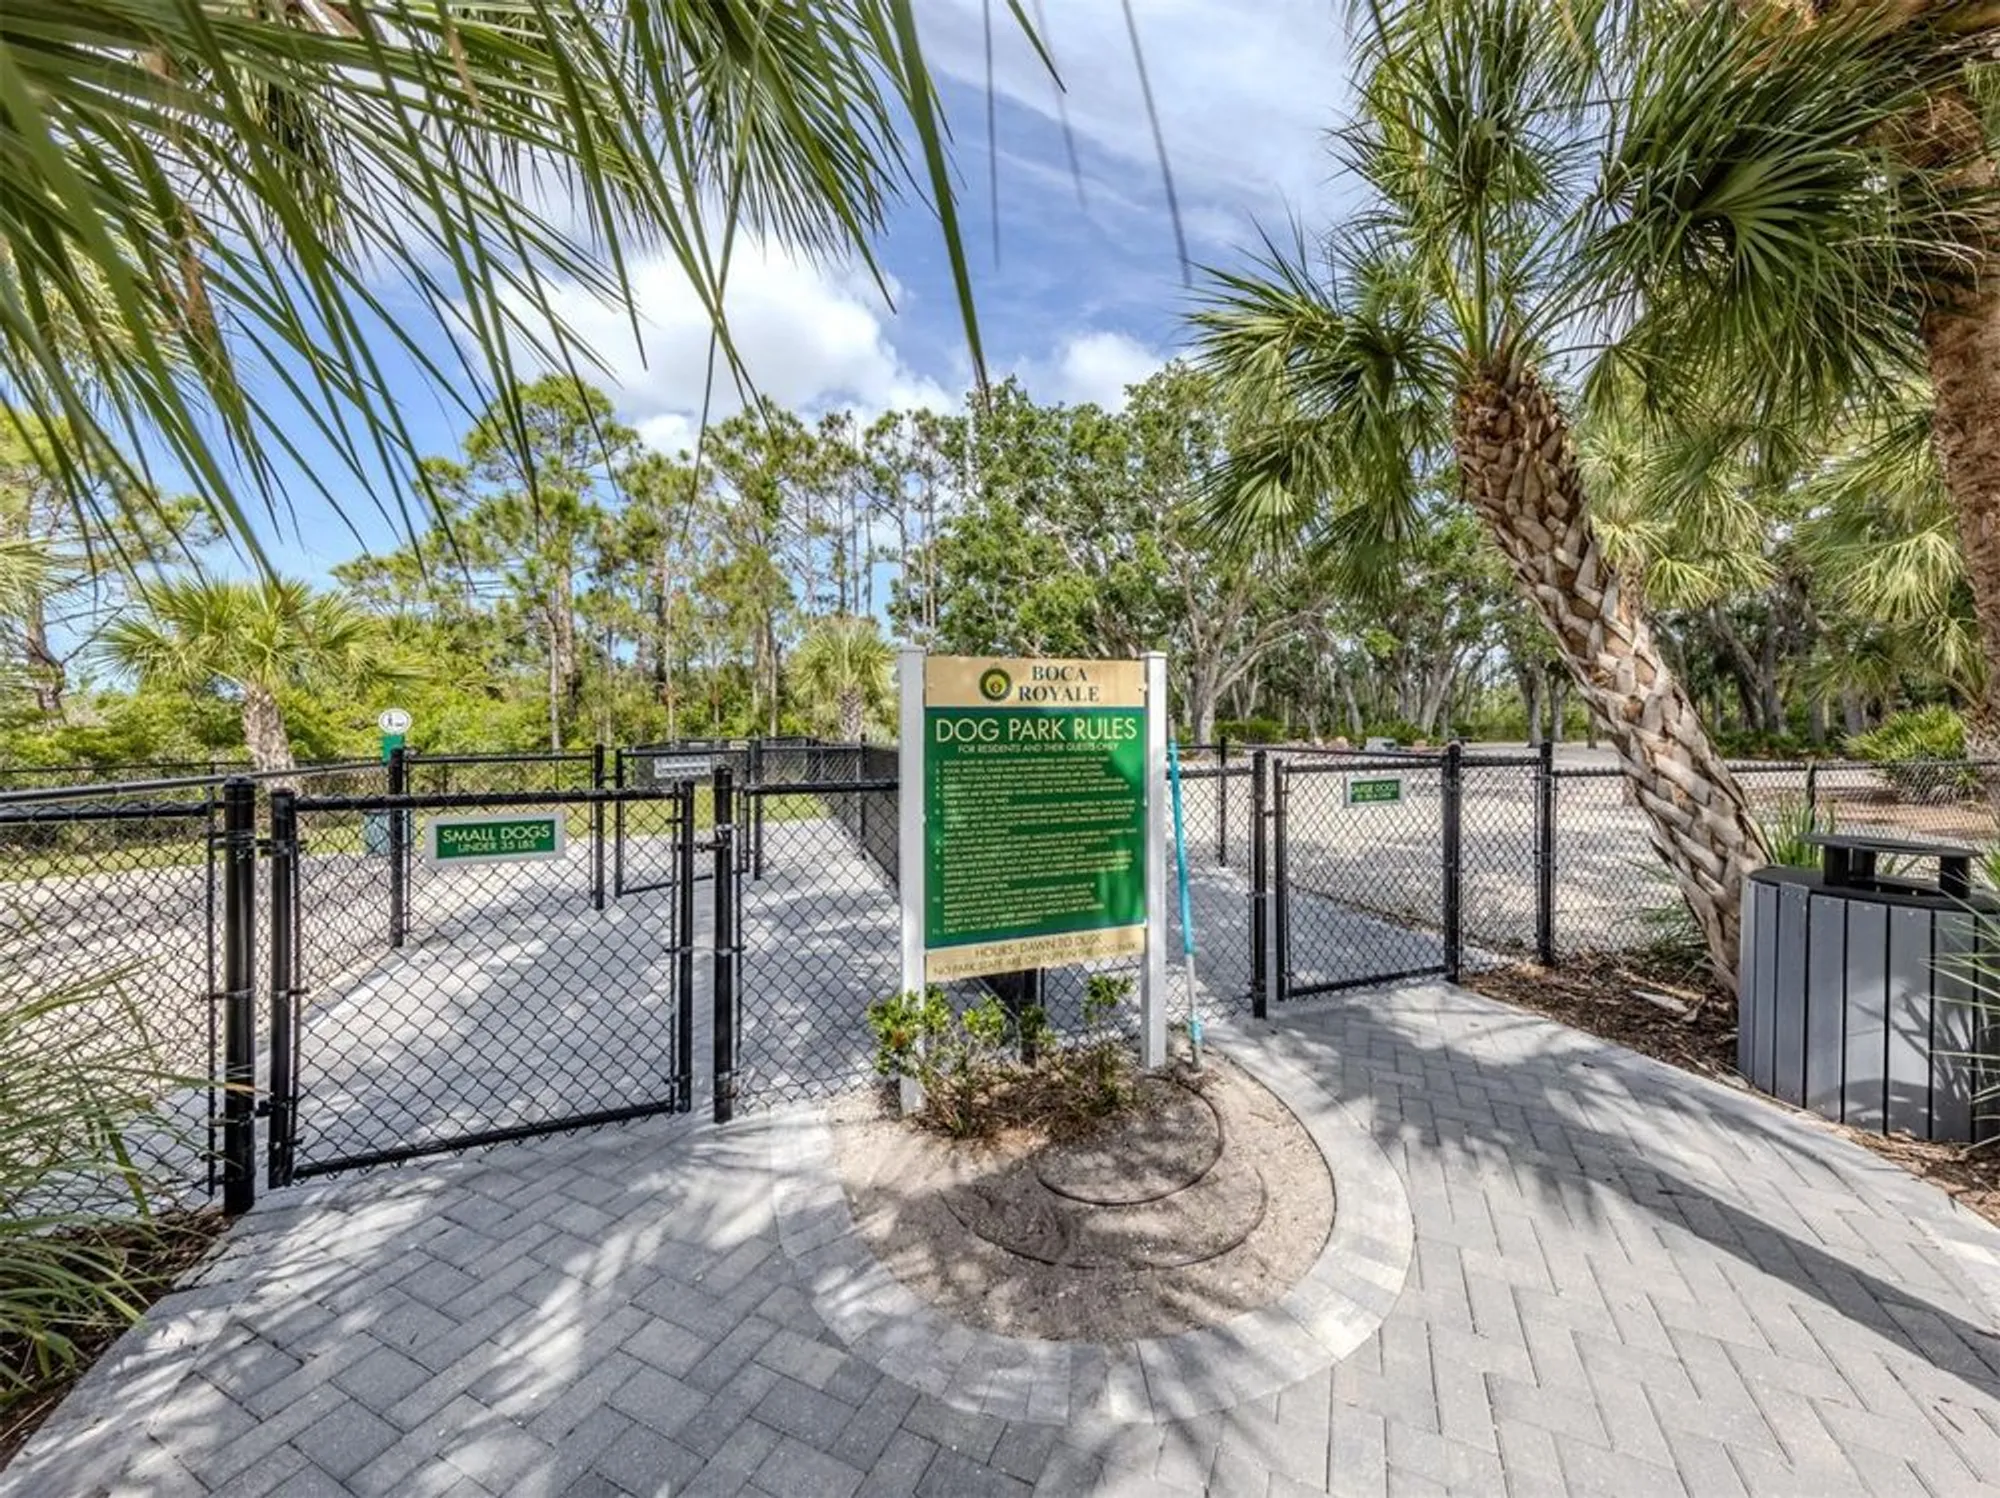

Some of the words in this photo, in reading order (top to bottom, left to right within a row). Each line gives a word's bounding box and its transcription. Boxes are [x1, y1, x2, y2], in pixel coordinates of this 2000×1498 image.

[1032, 665, 1087, 682] BOCA
[1018, 685, 1100, 702] ROYALE
[935, 717, 1000, 743] DOG
[1008, 717, 1066, 742] PARK
[1073, 717, 1137, 741] RULES
[958, 744, 975, 754] FOR
[978, 743, 1021, 753] RESIDENTS
[1022, 743, 1042, 753] AND
[443, 827, 496, 843] SMALL
[500, 824, 550, 840] DOGS
[458, 841, 497, 853] UNDER
[1020, 938, 1055, 952] DAWN
[1058, 936, 1073, 948] TO
